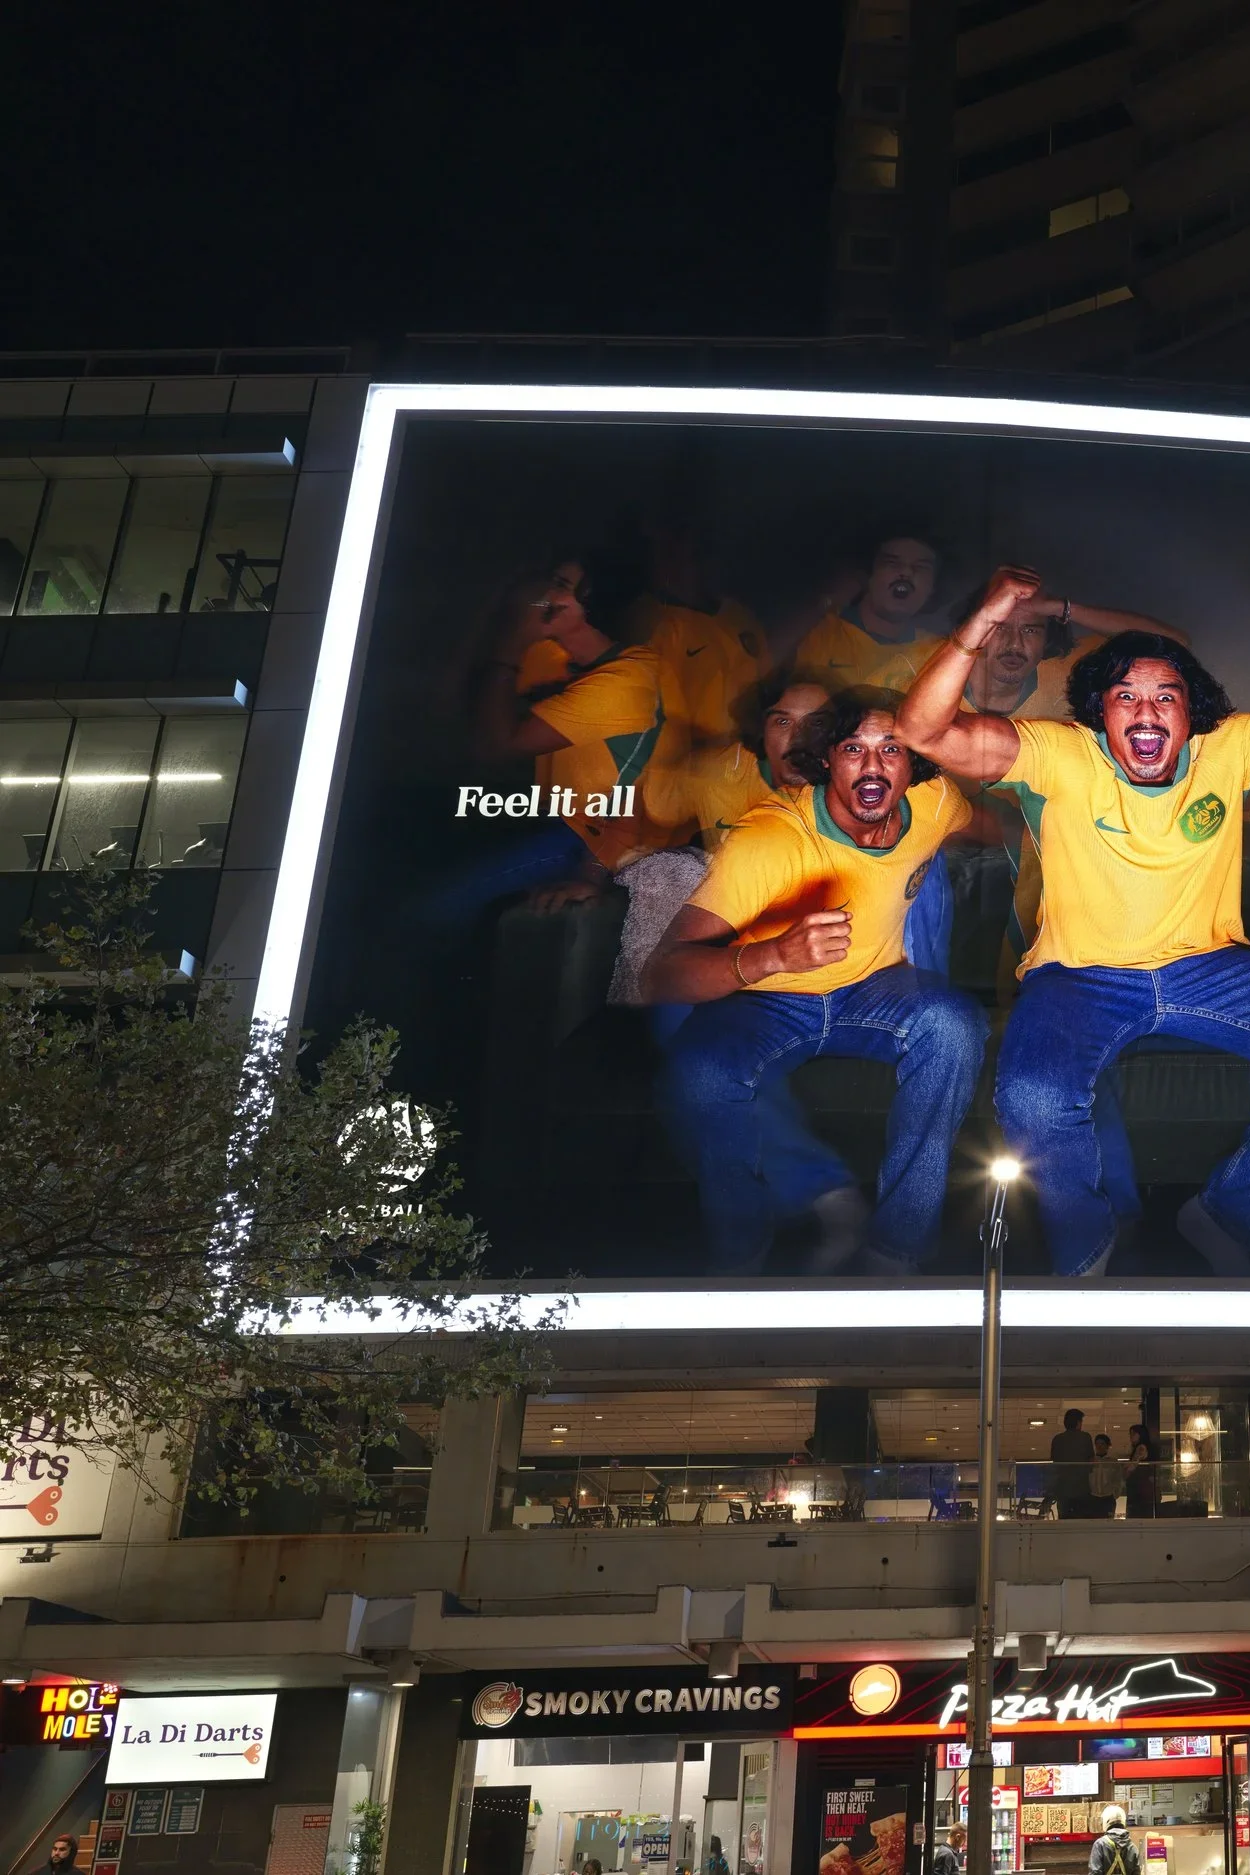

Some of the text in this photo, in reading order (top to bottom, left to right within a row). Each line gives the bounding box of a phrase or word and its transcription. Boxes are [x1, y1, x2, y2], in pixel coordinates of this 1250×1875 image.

[454, 785, 635, 817] Feel it all
[524, 1685, 781, 1716] SMOKY CRAVINGS
[939, 1684, 1139, 1729] Pzza Hut
[121, 1723, 263, 1744] La Di Darts
[827, 1791, 876, 1803] FIRST SWEET.
[827, 1803, 867, 1814] THEN HEAT.
[643, 1843, 669, 1855] OPEN
